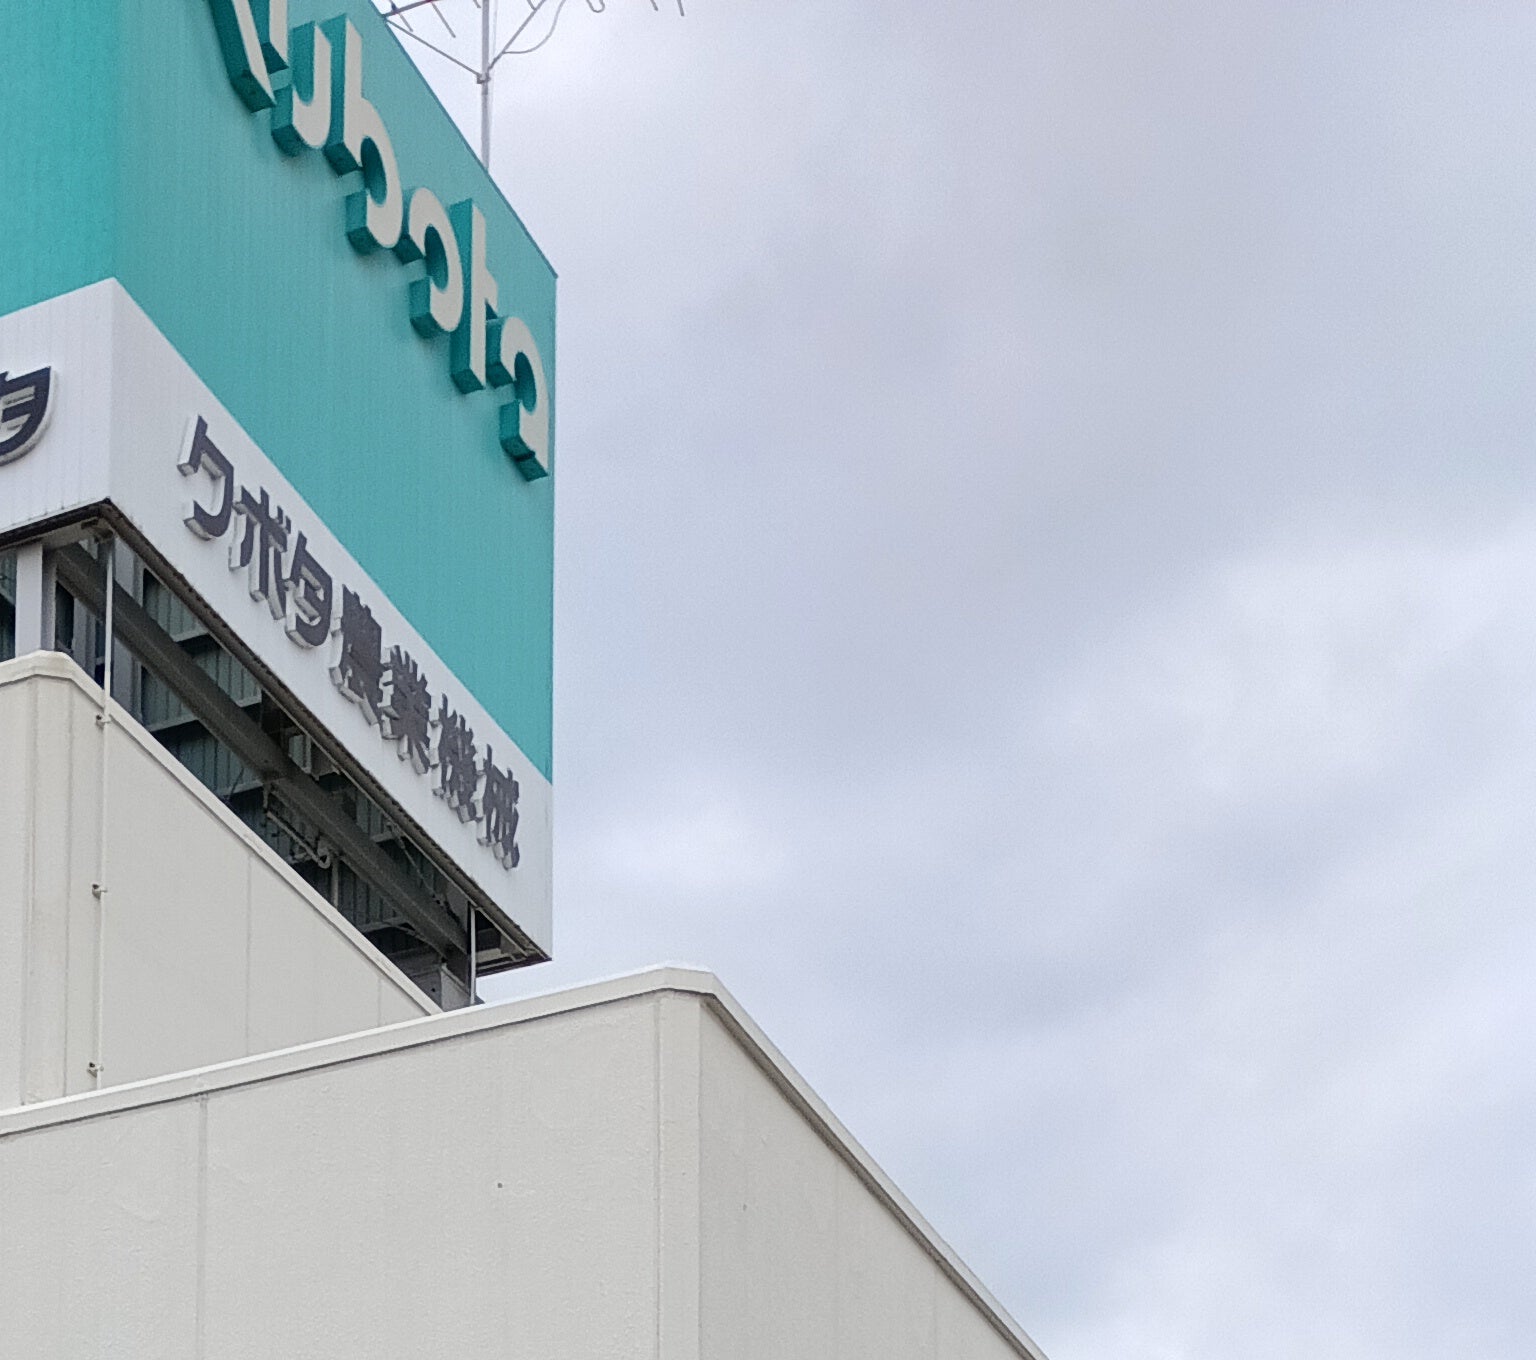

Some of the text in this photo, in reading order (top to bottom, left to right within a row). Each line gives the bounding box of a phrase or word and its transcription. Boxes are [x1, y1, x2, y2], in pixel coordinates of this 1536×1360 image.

[177, 415, 520, 869] クボタ農業機械
